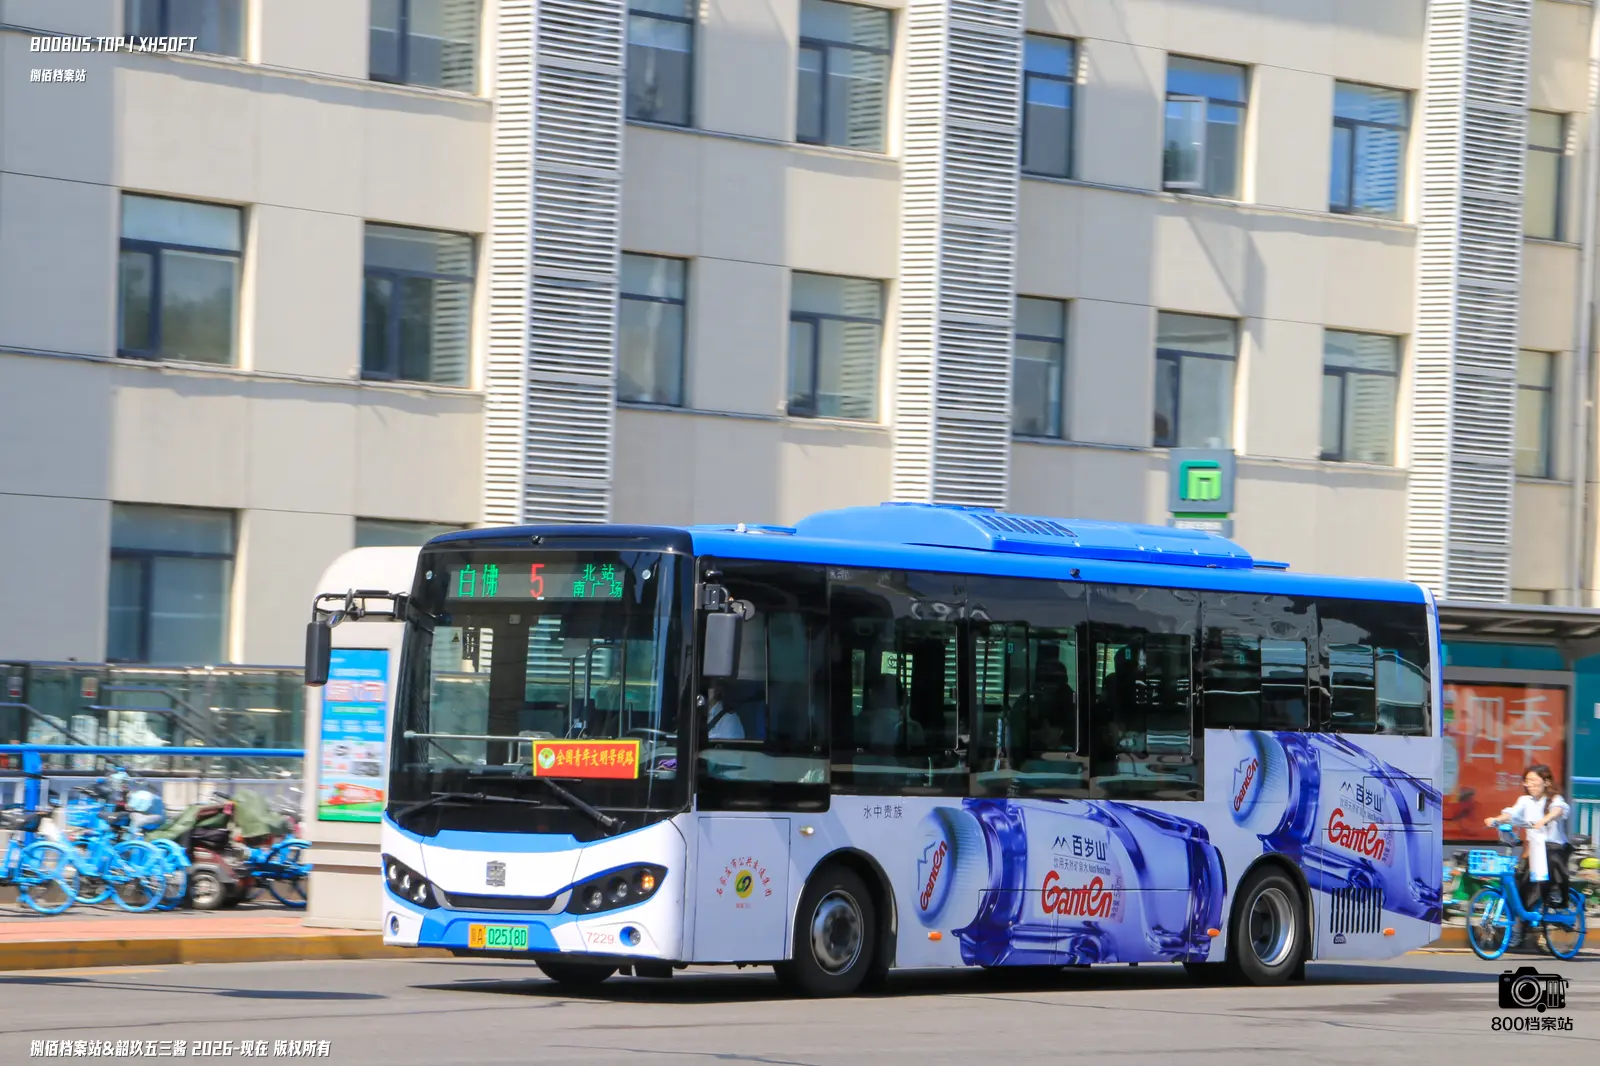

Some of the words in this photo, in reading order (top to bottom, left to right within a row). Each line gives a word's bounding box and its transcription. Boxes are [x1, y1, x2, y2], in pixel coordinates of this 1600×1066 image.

[458, 563, 499, 598] 白佛
[529, 563, 545, 598] 5
[583, 563, 615, 581] 北站
[573, 581, 623, 598] 南广场
[1464, 695, 1552, 767] 四季
[863, 805, 903, 819] 水中贵族
[1355, 783, 1384, 813] 百岁山
[1072, 835, 1107, 861] 百岁山
[1328, 808, 1386, 861] Ganten
[1041, 870, 1113, 918] Ganten
[586, 932, 615, 945] 7229
